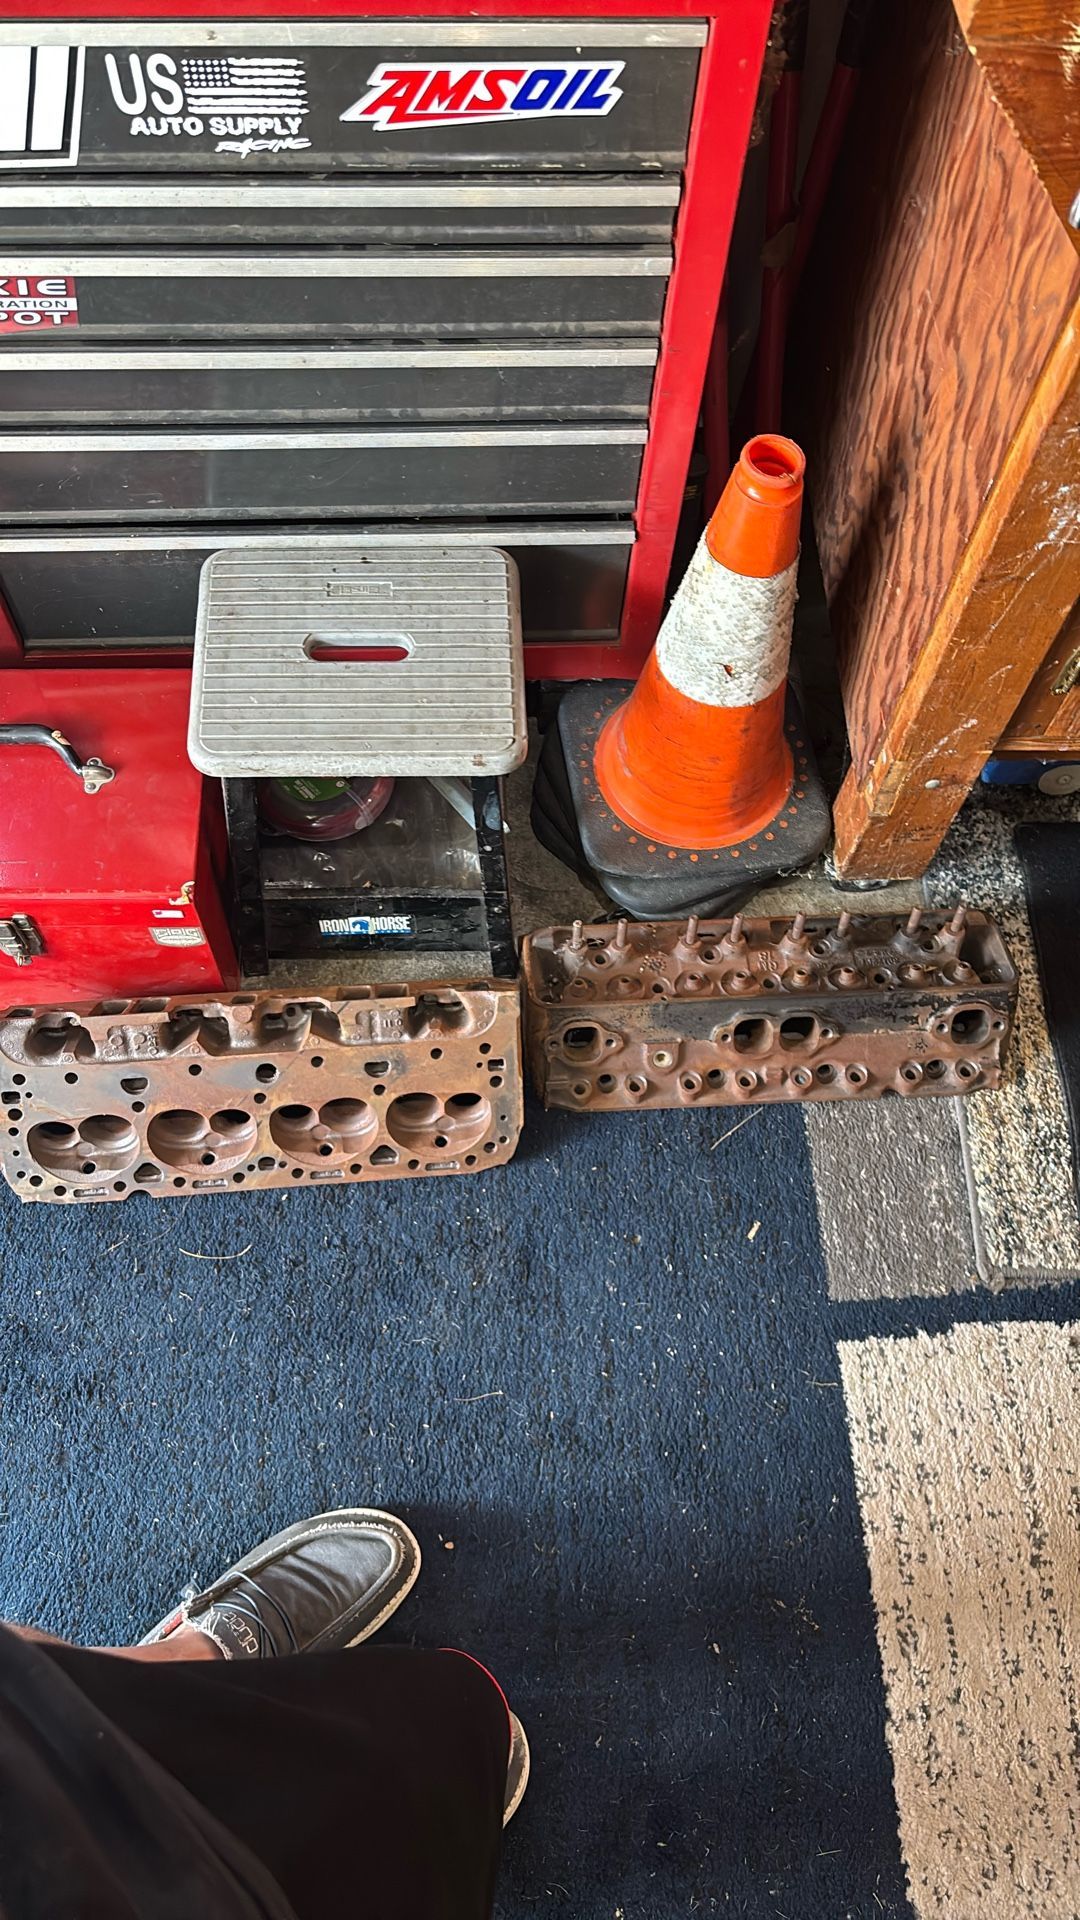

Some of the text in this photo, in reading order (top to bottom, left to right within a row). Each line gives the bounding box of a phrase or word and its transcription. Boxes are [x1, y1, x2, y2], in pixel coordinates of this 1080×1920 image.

[104, 52, 184, 115] US
[359, 68, 614, 124] AMSOIL
[130, 116, 302, 136] AUTO SUPPLY
[214, 137, 312, 159] RACING
[319, 919, 349, 933] IRON
[371, 916, 412, 931] HORSE
